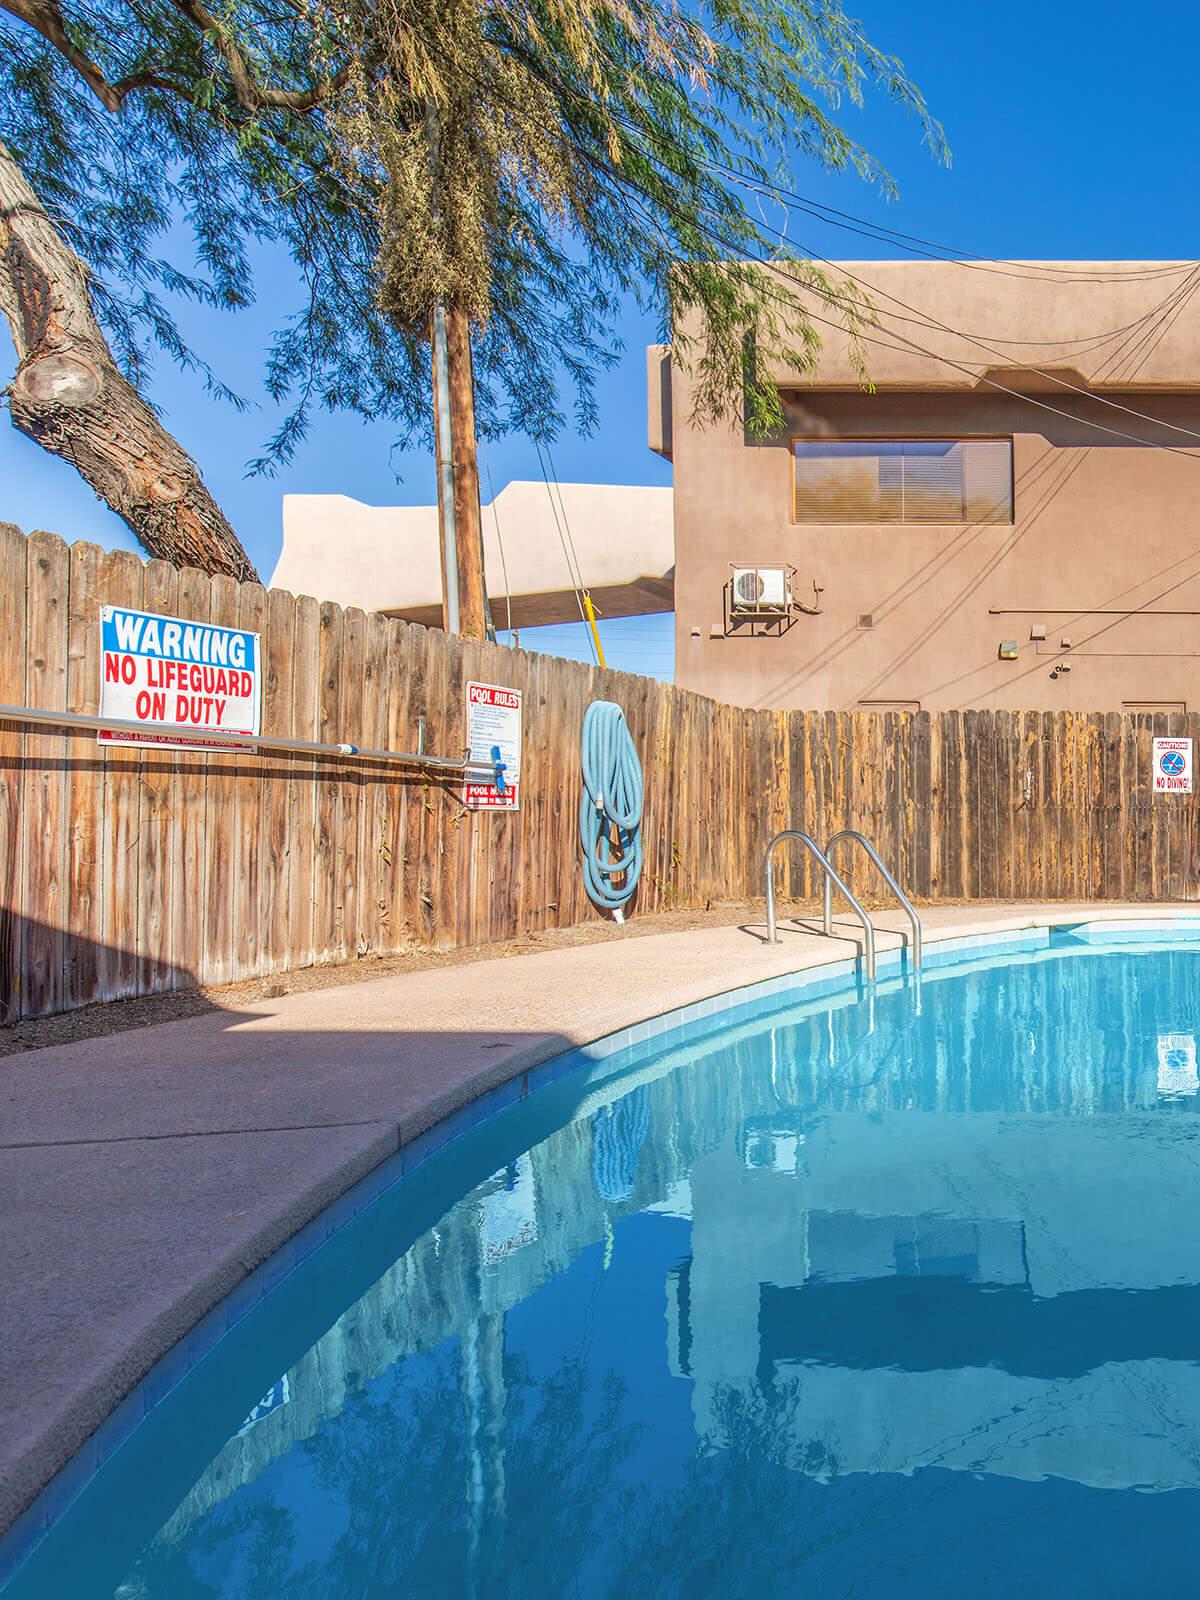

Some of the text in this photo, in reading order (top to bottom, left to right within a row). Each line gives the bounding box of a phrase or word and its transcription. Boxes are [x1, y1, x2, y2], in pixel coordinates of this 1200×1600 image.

[115, 613, 246, 668] WARNING
[105, 652, 252, 698] NO LIFEGUARD
[135, 690, 227, 726] ON DUTY
[471, 687, 518, 707] POOL RULES
[469, 785, 488, 795] POOL
[1156, 777, 1166, 788] NO
